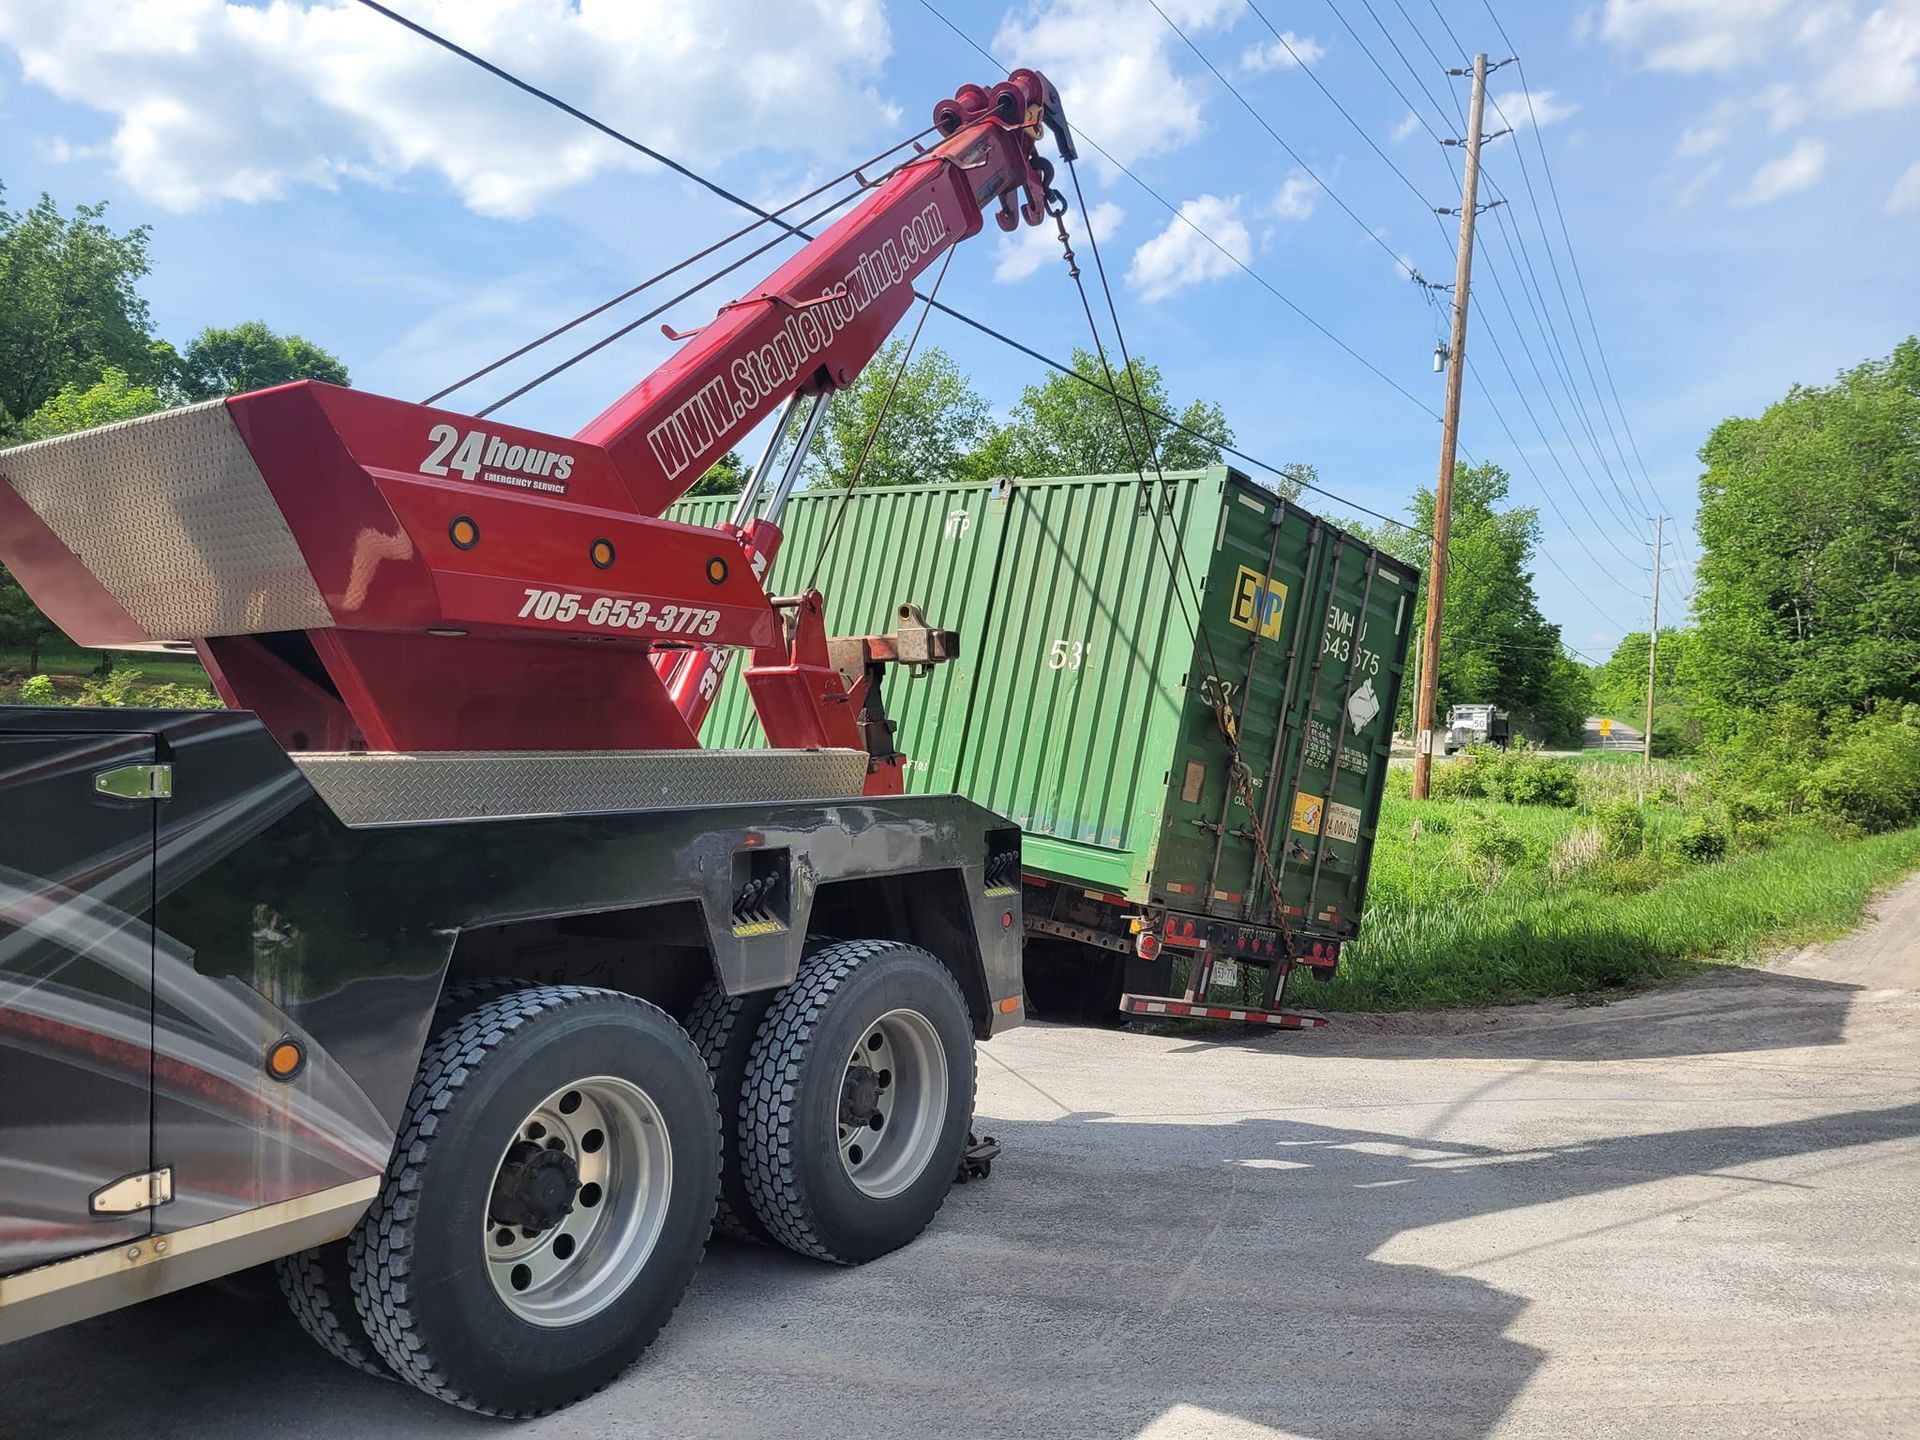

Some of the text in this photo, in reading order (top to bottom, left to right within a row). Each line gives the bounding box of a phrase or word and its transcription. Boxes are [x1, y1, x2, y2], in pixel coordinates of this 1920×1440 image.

[419, 424, 575, 481] 24 hours
[484, 472, 566, 494] EMERGENCY SERVICE
[517, 588, 720, 636] 705-653-3773
